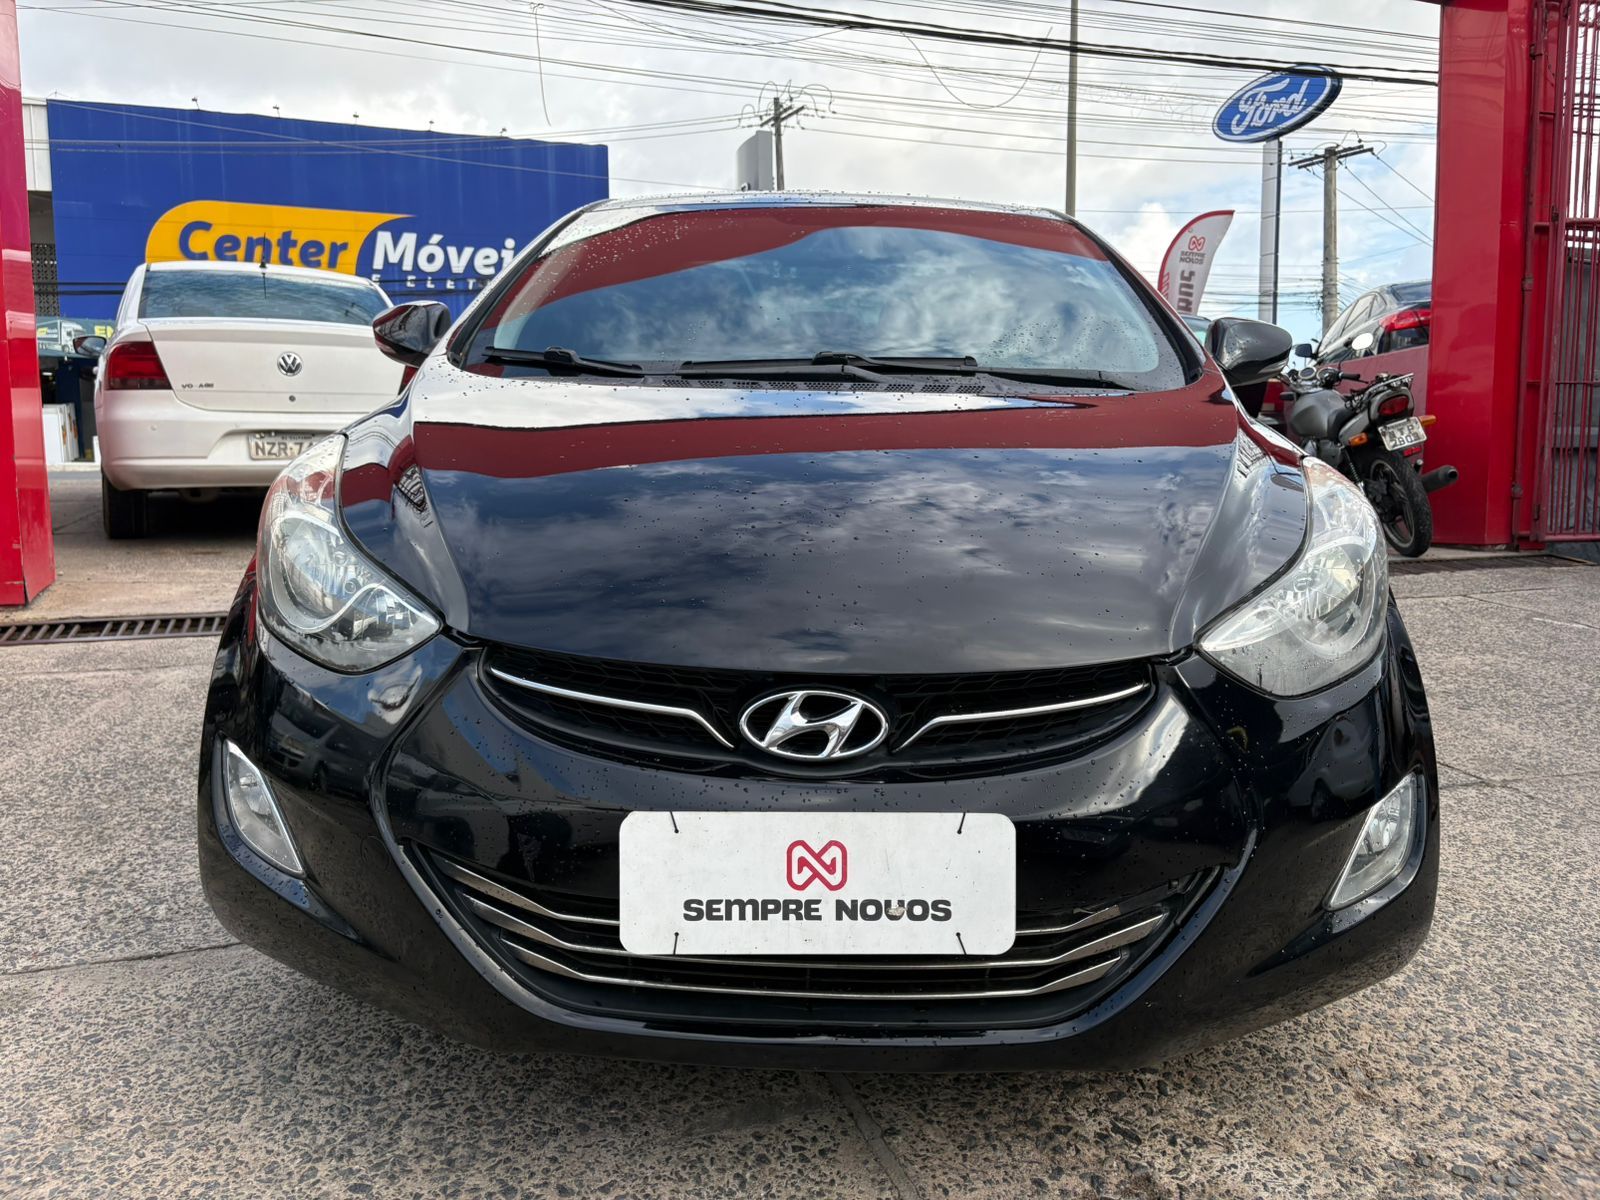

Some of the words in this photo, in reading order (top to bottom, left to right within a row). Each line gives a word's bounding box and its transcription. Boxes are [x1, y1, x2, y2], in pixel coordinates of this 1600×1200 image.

[1231, 78, 1308, 135] Ford
[179, 220, 349, 269] Center
[372, 230, 515, 275] Móvei
[406, 275, 491, 291] ELET
[683, 898, 822, 922] SEMPRE
